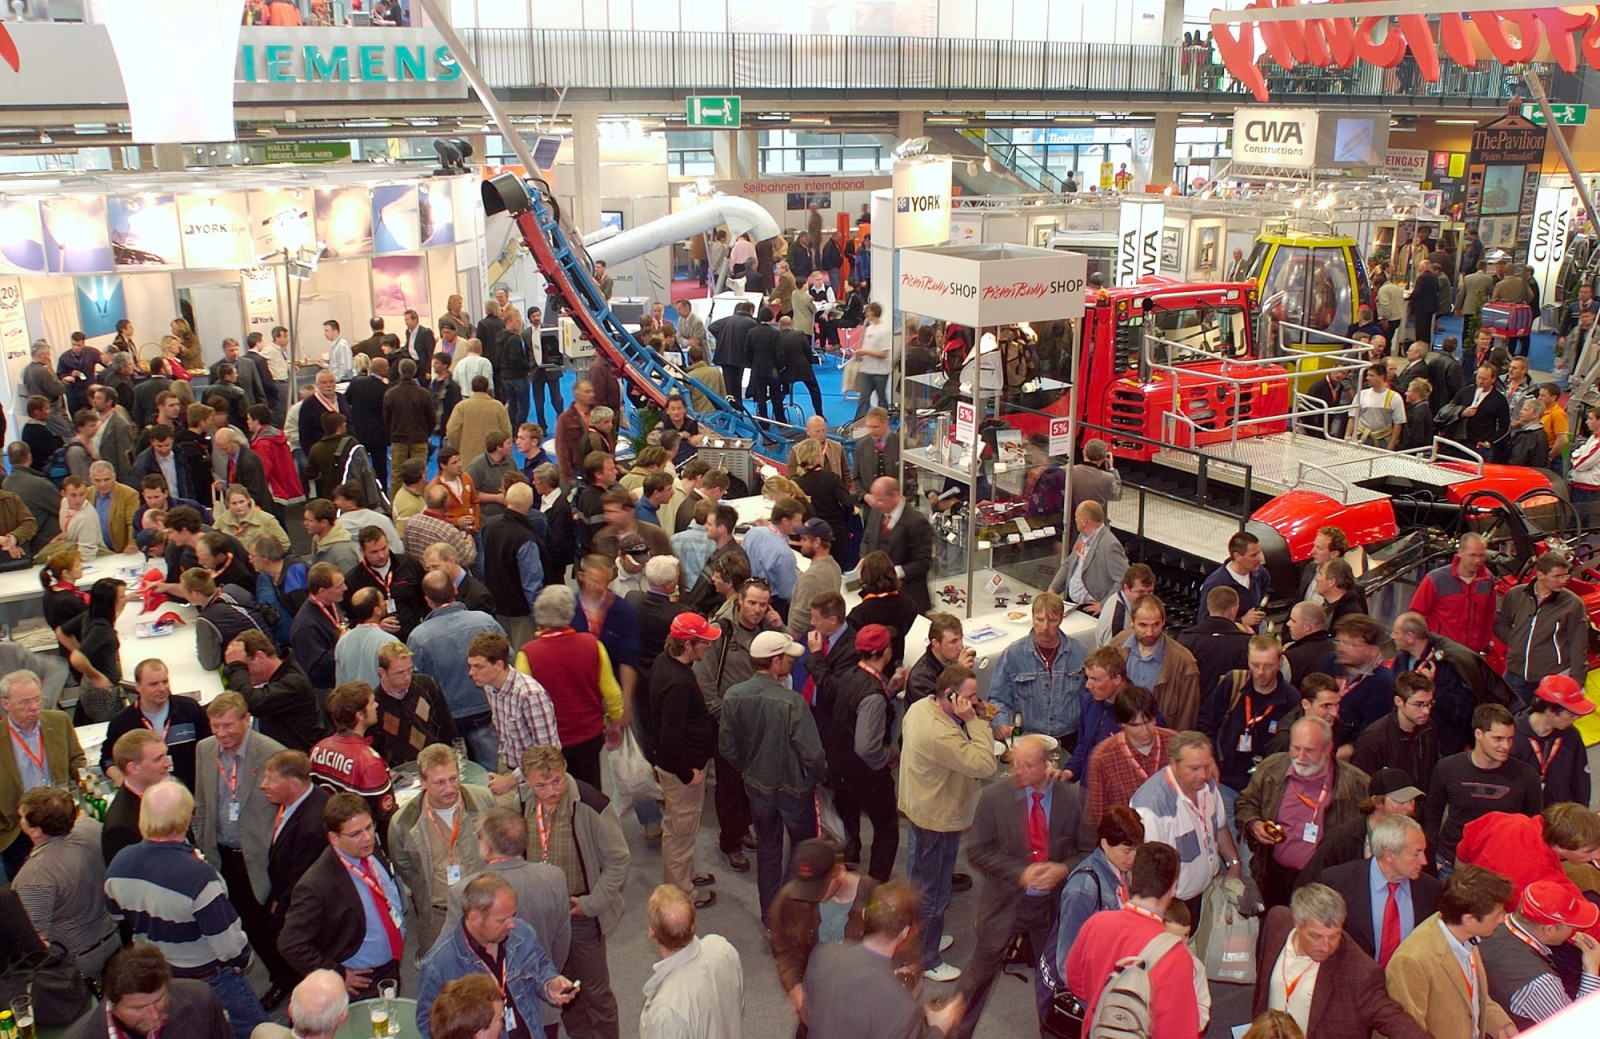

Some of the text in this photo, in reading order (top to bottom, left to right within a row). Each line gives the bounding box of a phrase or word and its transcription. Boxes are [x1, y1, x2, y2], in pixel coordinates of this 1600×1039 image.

[241, 44, 462, 83] IEMENS
[1245, 121, 1303, 144] CWA
[1243, 144, 1303, 156] Constructions
[743, 180, 865, 193] Seilbahnen international
[911, 195, 941, 212] YORK
[195, 223, 228, 233] YORK
[1533, 209, 1553, 262] CWA
[1553, 209, 1568, 262] CWA
[901, 272, 977, 298] PistenBully SHOP
[982, 279, 1084, 300] PistenBully SHOP
[959, 408, 973, 421] 5%
[1053, 422, 1068, 434] 5%
